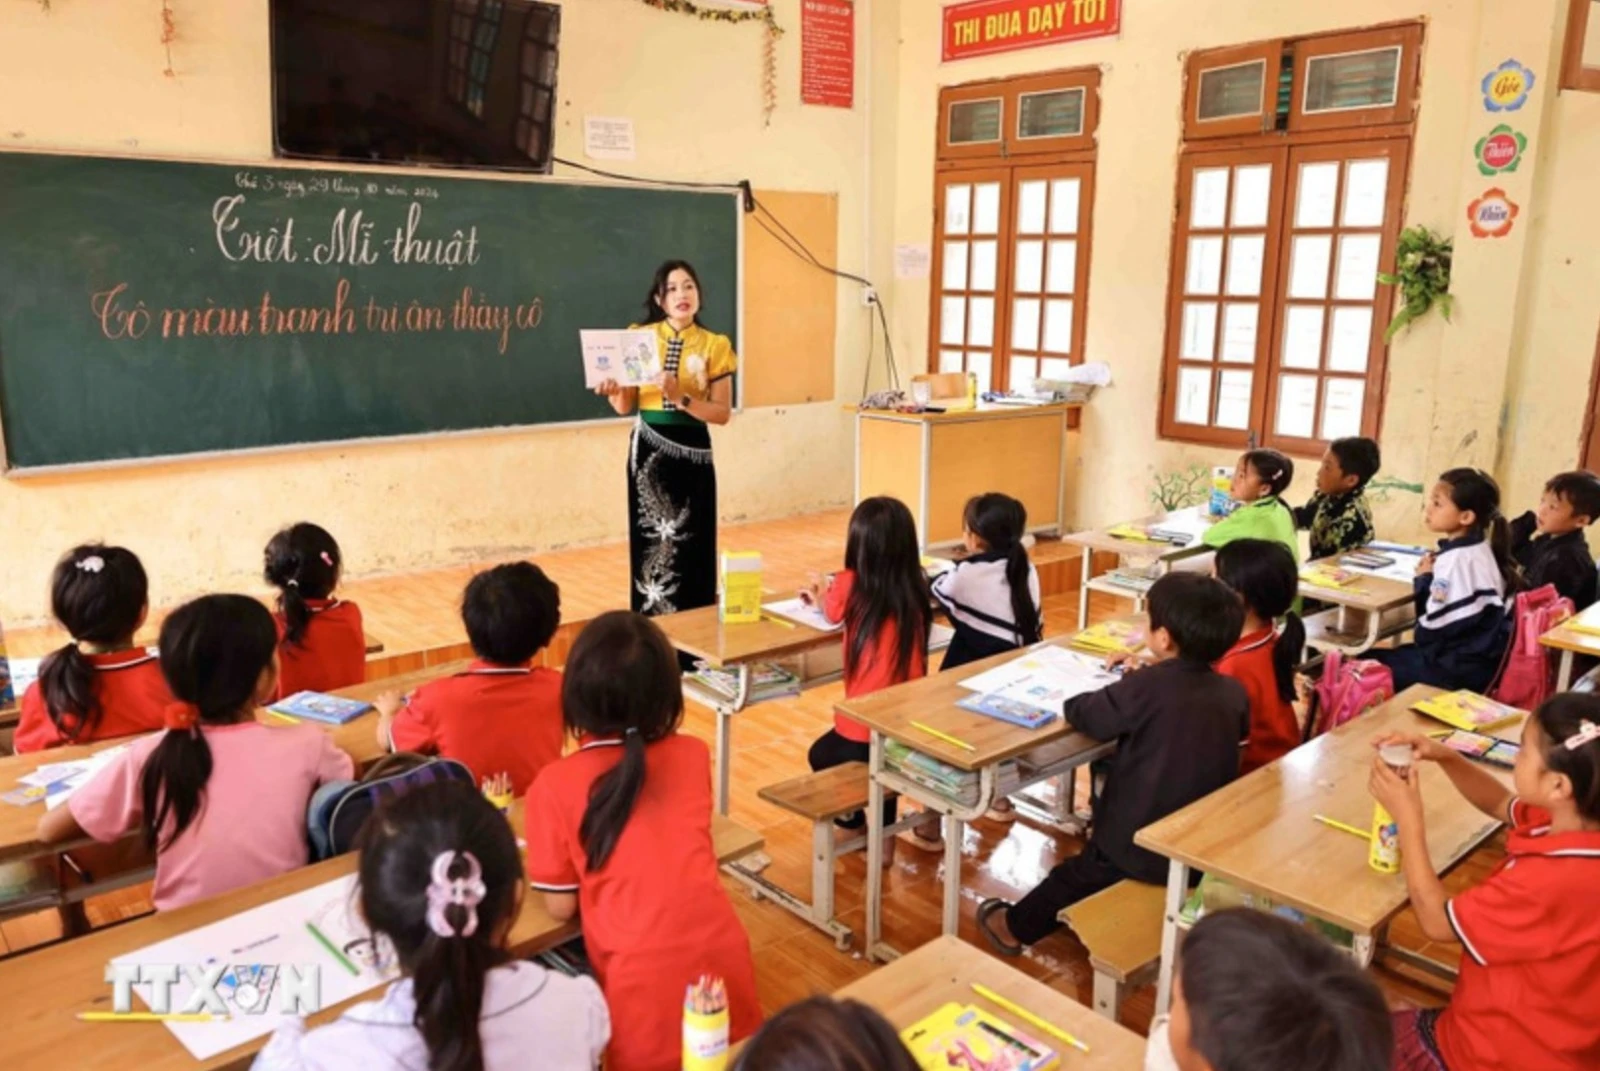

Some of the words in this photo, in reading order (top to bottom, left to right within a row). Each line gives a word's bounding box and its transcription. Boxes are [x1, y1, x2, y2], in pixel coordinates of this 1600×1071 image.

[954, 18, 981, 46] THI
[985, 10, 1022, 41] ĐUA
[1028, 1, 1067, 37] DẠY
[308, 176, 329, 192] 29
[313, 207, 379, 265] Mĩ
[384, 201, 480, 271] thuật
[91, 282, 150, 340] Tô
[161, 297, 254, 338] màu
[258, 278, 357, 334] tranh
[405, 299, 446, 332] ân
[449, 285, 512, 355] thầy
[516, 296, 544, 330] cô
